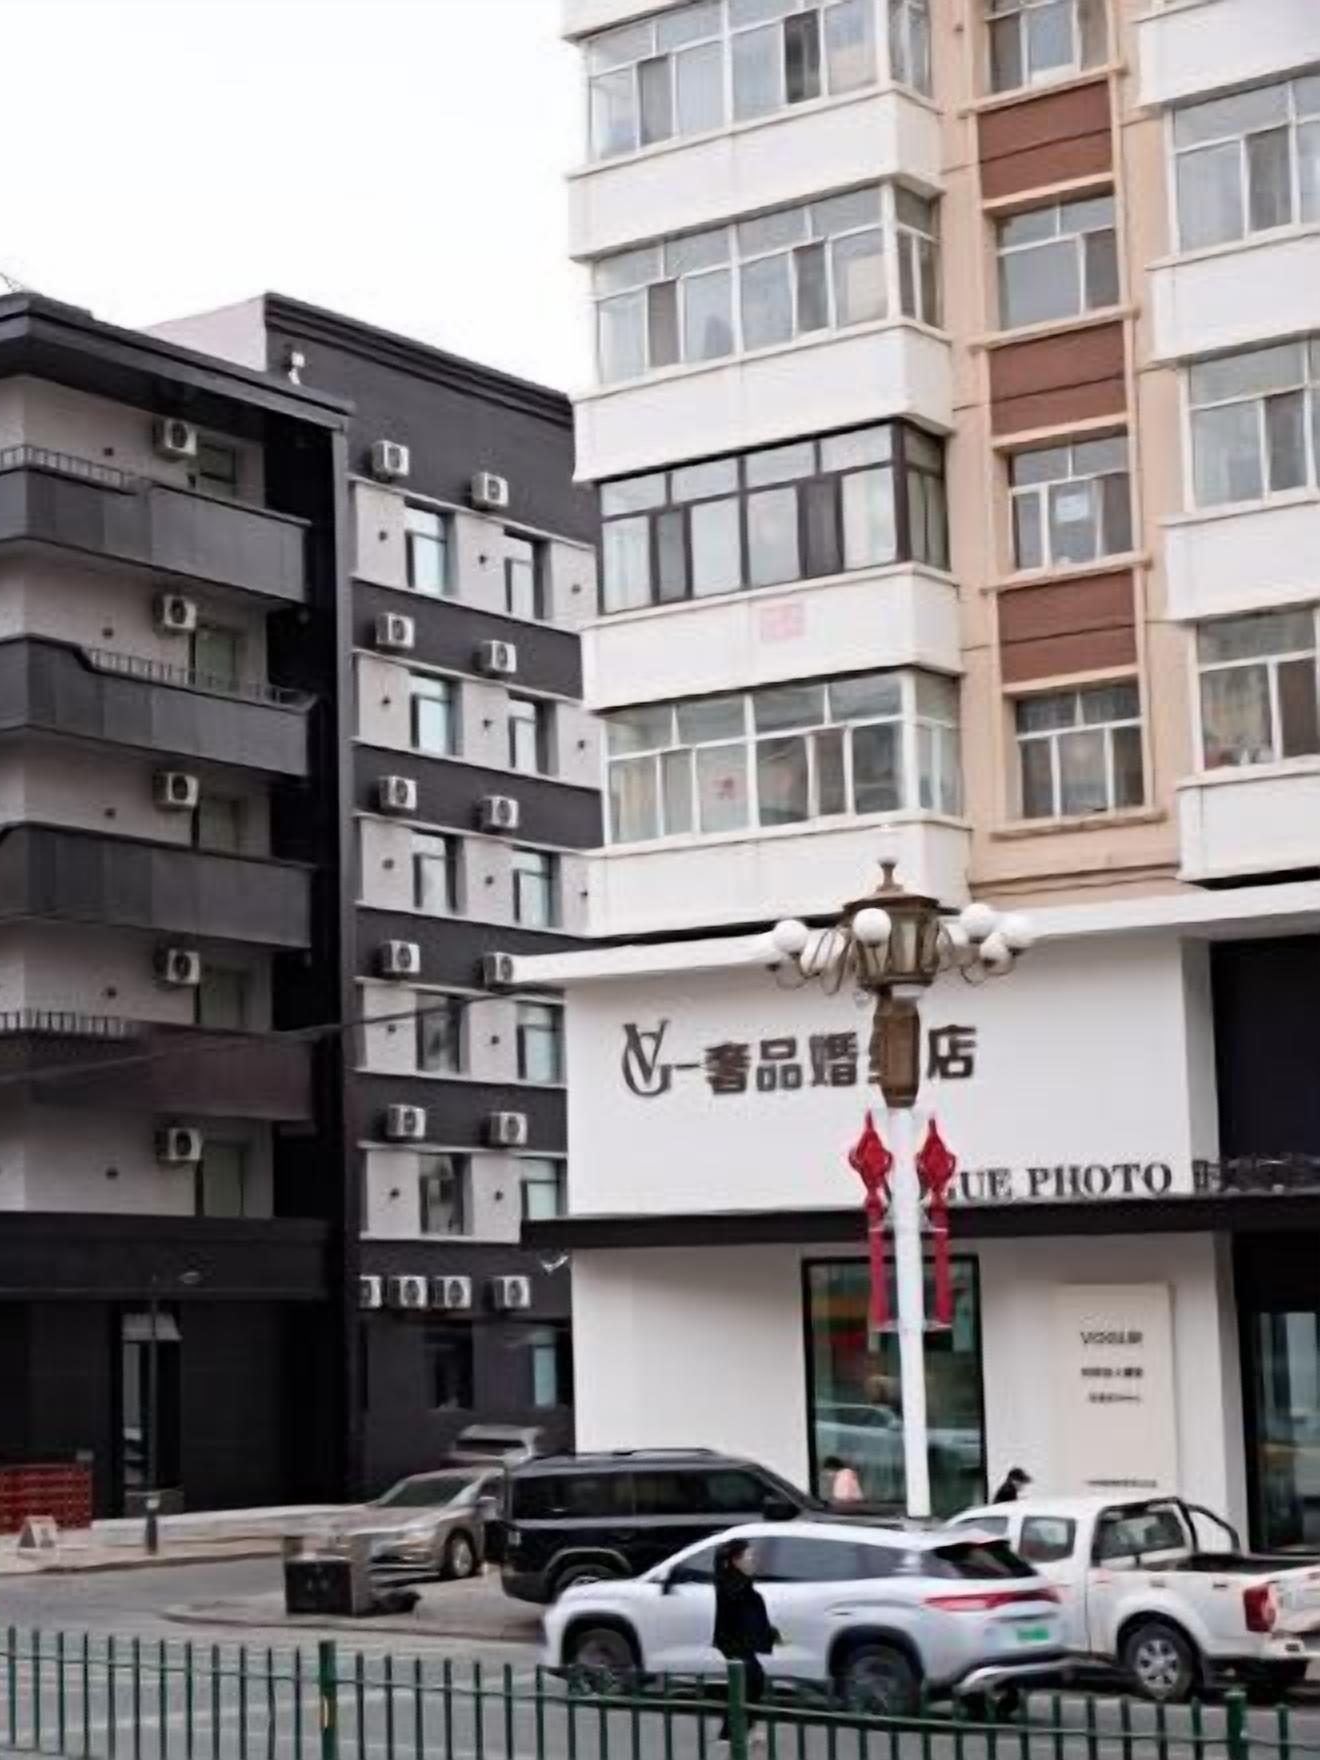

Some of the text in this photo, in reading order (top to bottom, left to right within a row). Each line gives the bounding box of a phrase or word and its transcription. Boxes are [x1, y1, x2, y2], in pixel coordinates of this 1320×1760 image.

[703, 1023, 977, 1095] 奢品婚店
[1027, 1163, 1172, 1197] PHOTO
